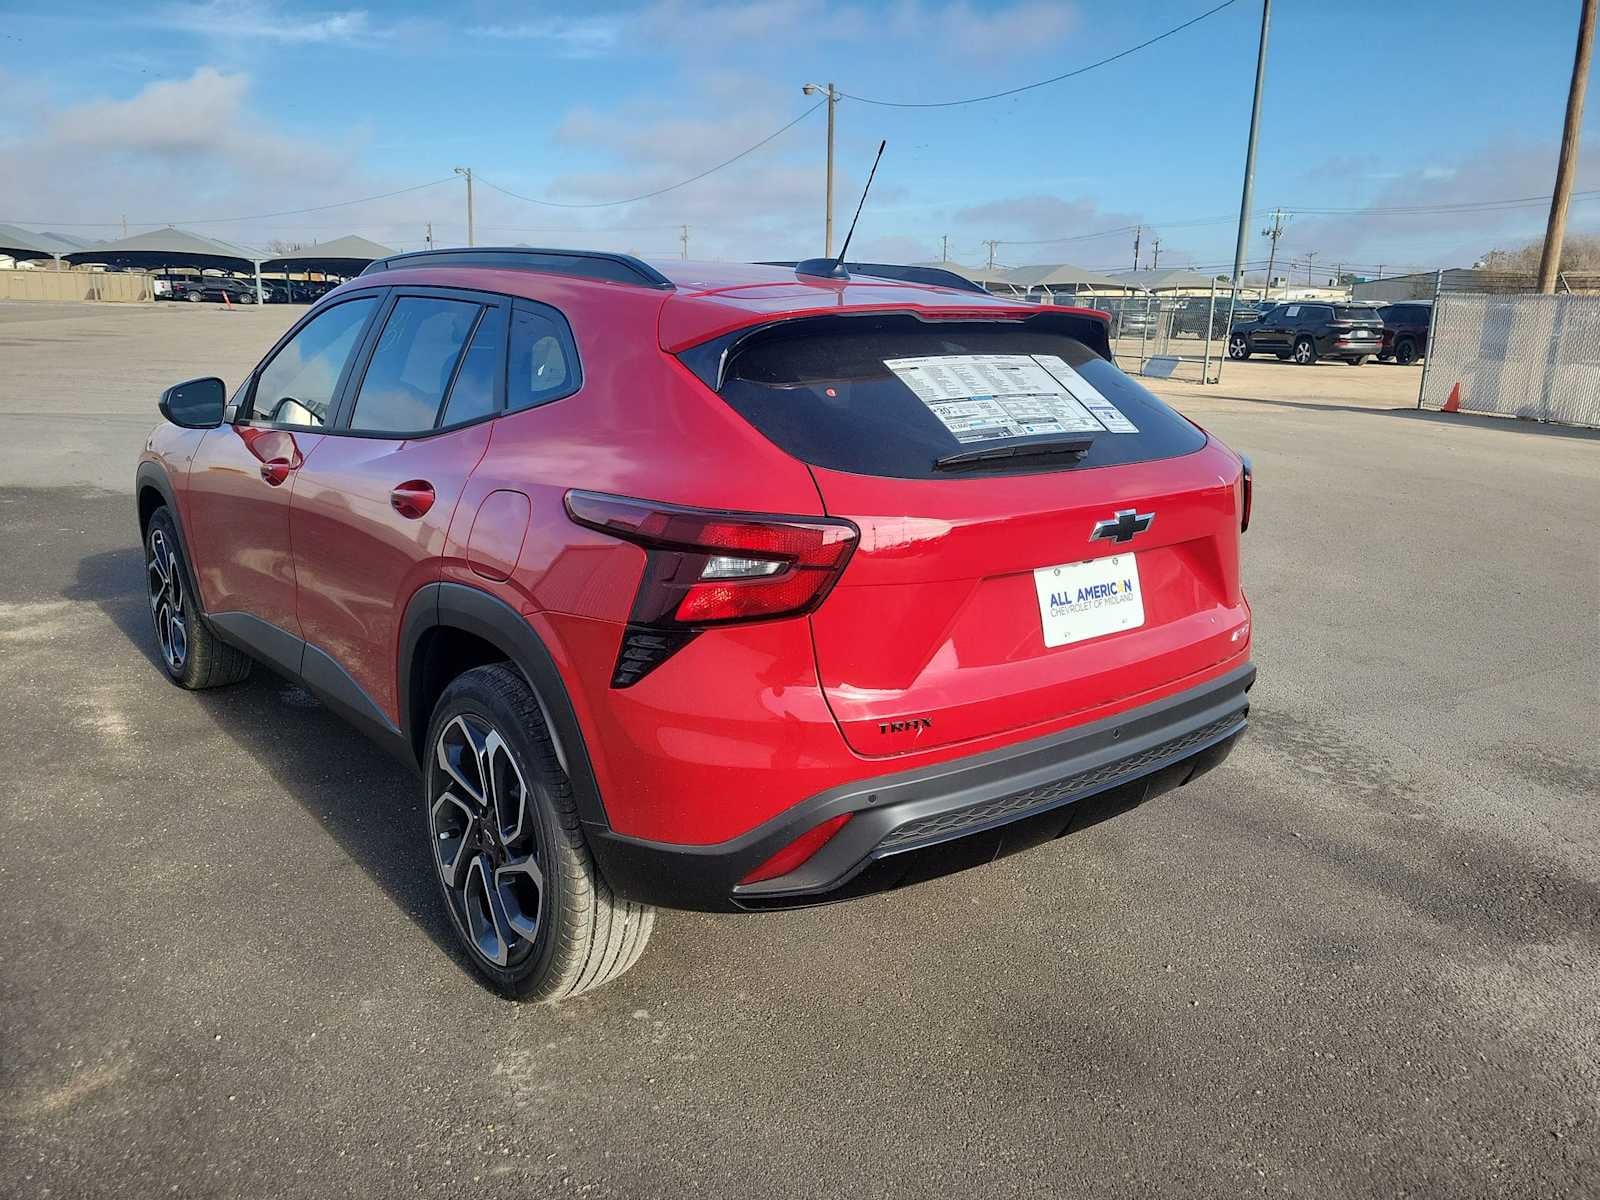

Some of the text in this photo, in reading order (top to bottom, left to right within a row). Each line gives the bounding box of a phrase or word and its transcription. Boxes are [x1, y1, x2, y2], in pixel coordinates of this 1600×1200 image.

[1050, 591, 1073, 608] ALL
[1050, 592, 1134, 617] CHEVROLET OF MIDLAND
[879, 718, 933, 735] TRAX
